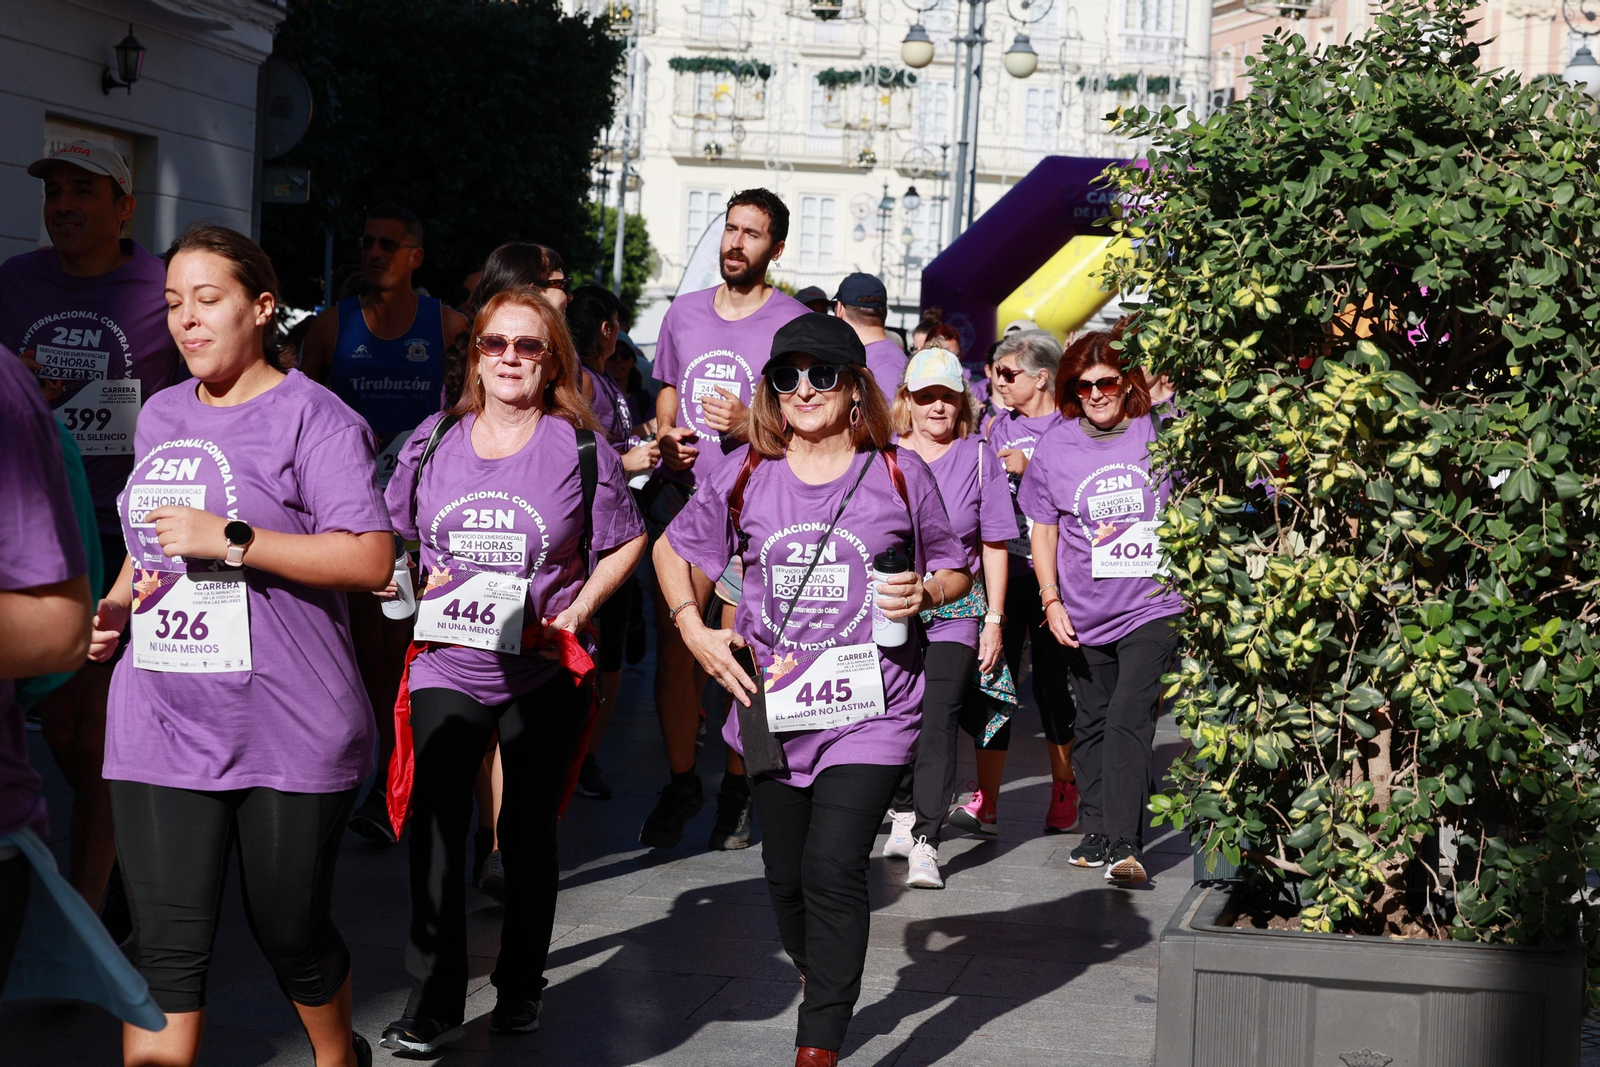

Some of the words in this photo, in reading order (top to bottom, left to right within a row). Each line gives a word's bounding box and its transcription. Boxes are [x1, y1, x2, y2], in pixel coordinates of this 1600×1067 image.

[1073, 207, 1090, 218] DE
[1093, 208, 1110, 218] LA
[22, 310, 98, 345] INTERNACIONAL
[100, 316, 130, 352] CONTRA
[124, 352, 133, 368] LA
[51, 326, 102, 348] 25N
[39, 347, 63, 356] SERVICIO
[70, 350, 107, 360] EMERGENCIAS
[46, 355, 58, 365] 24
[60, 358, 96, 369] HORAS
[683, 349, 735, 379] INTERNACIONAL
[734, 354, 755, 383] CONTRA
[61, 369, 72, 378] 21
[74, 370, 85, 379] 21
[87, 370, 102, 380] 30
[704, 362, 737, 379] 25N
[102, 386, 137, 394] CARRERA
[350, 376, 431, 391] Tirabuzón
[701, 385, 710, 393] 24
[63, 408, 112, 431] 399
[76, 433, 86, 441] EL
[87, 433, 127, 441] SILENCIO
[144, 457, 202, 481] 25N
[202, 440, 234, 485] CONTRA
[224, 485, 238, 506] LA
[1074, 462, 1126, 502] INTERNACIONAL
[1095, 473, 1133, 494] 25N
[162, 488, 203, 496] EMERGENCIAS
[137, 496, 150, 508] 24
[151, 496, 192, 508] HORAS
[1092, 508, 1110, 518] 900
[1111, 506, 1120, 514] 21
[1129, 502, 1141, 511] 30
[1096, 500, 1106, 509] 24
[1107, 495, 1135, 506] HORAS
[430, 490, 510, 533] INTERNACIONAL
[511, 495, 547, 533] CONTRA
[541, 533, 550, 550] LA
[461, 508, 515, 529] 25N
[460, 540, 473, 550] 24
[474, 541, 514, 551] HORAS
[833, 527, 870, 562] CONTRA
[1109, 542, 1154, 559] 404
[478, 552, 489, 562] 21
[491, 552, 503, 562] 21
[505, 552, 522, 562] 30
[786, 541, 837, 565] 25N
[195, 581, 241, 591] CARRERA
[783, 575, 796, 585] 24
[777, 585, 800, 596] 900
[802, 586, 811, 596] 21
[812, 586, 824, 596] 21
[825, 586, 843, 597] 30
[443, 599, 497, 625] 446
[155, 608, 209, 641] 326
[437, 621, 447, 630] NI
[448, 624, 467, 632] UNA
[468, 626, 500, 637] MENOS
[149, 641, 158, 651] NI
[158, 642, 179, 653] UNA
[180, 644, 220, 654] MENOS
[837, 651, 874, 662] CARRERA
[795, 678, 853, 707] 445
[775, 712, 786, 721] EL
[786, 709, 817, 720] AMOR
[818, 706, 834, 716] NO
[835, 700, 877, 713] LASTIMA
